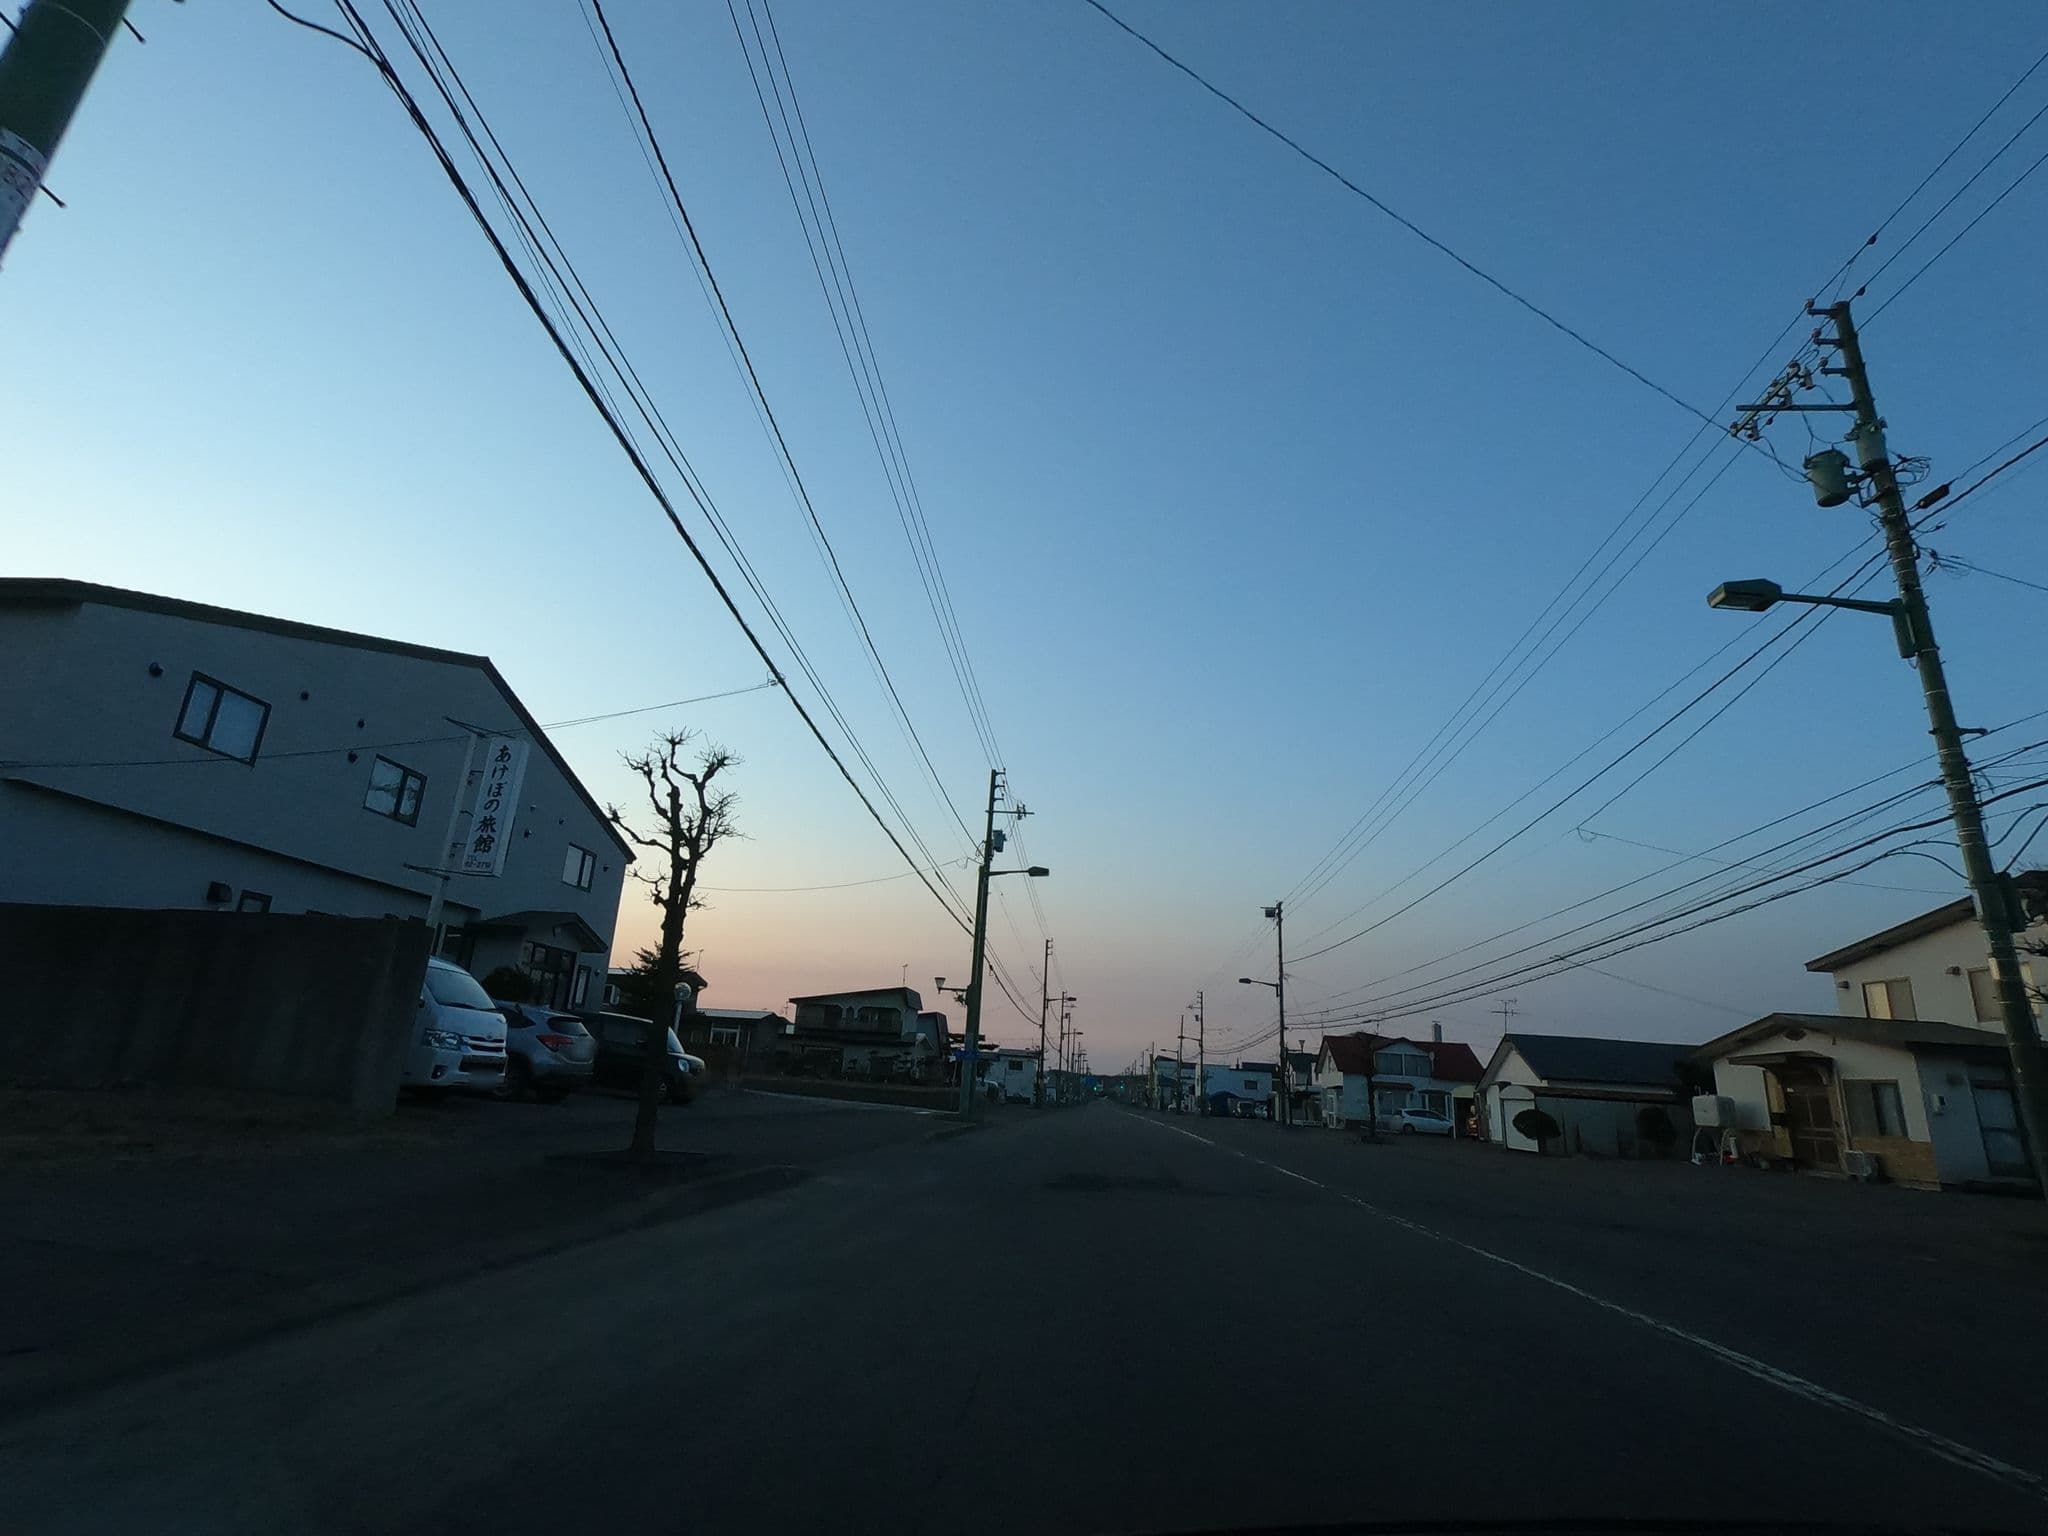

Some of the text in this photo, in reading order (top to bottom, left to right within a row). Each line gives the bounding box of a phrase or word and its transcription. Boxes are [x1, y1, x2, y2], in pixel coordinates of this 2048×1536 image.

[473, 744, 512, 854] あけぼの旅館
